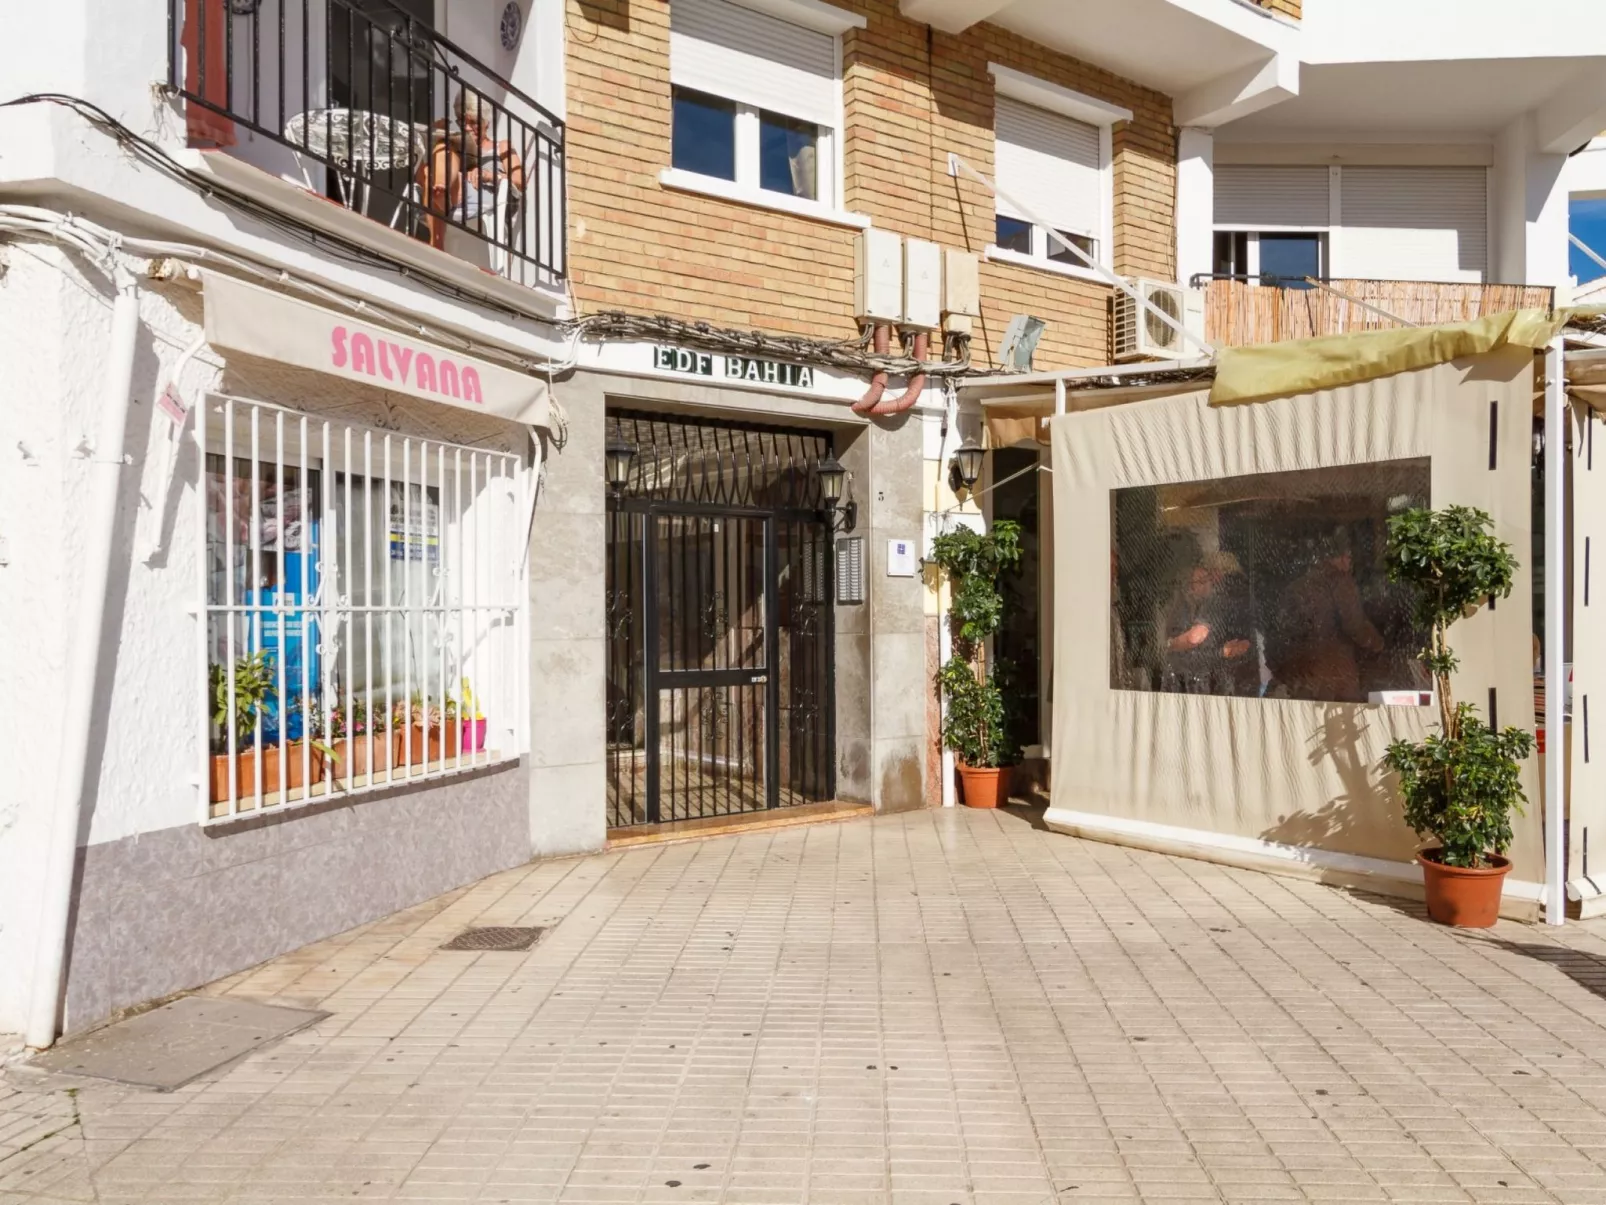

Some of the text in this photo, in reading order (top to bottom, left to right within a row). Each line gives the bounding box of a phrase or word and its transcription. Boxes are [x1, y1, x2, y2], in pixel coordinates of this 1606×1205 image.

[331, 326, 483, 404] SALVANA
[655, 346, 813, 388] EDF BAHIA
